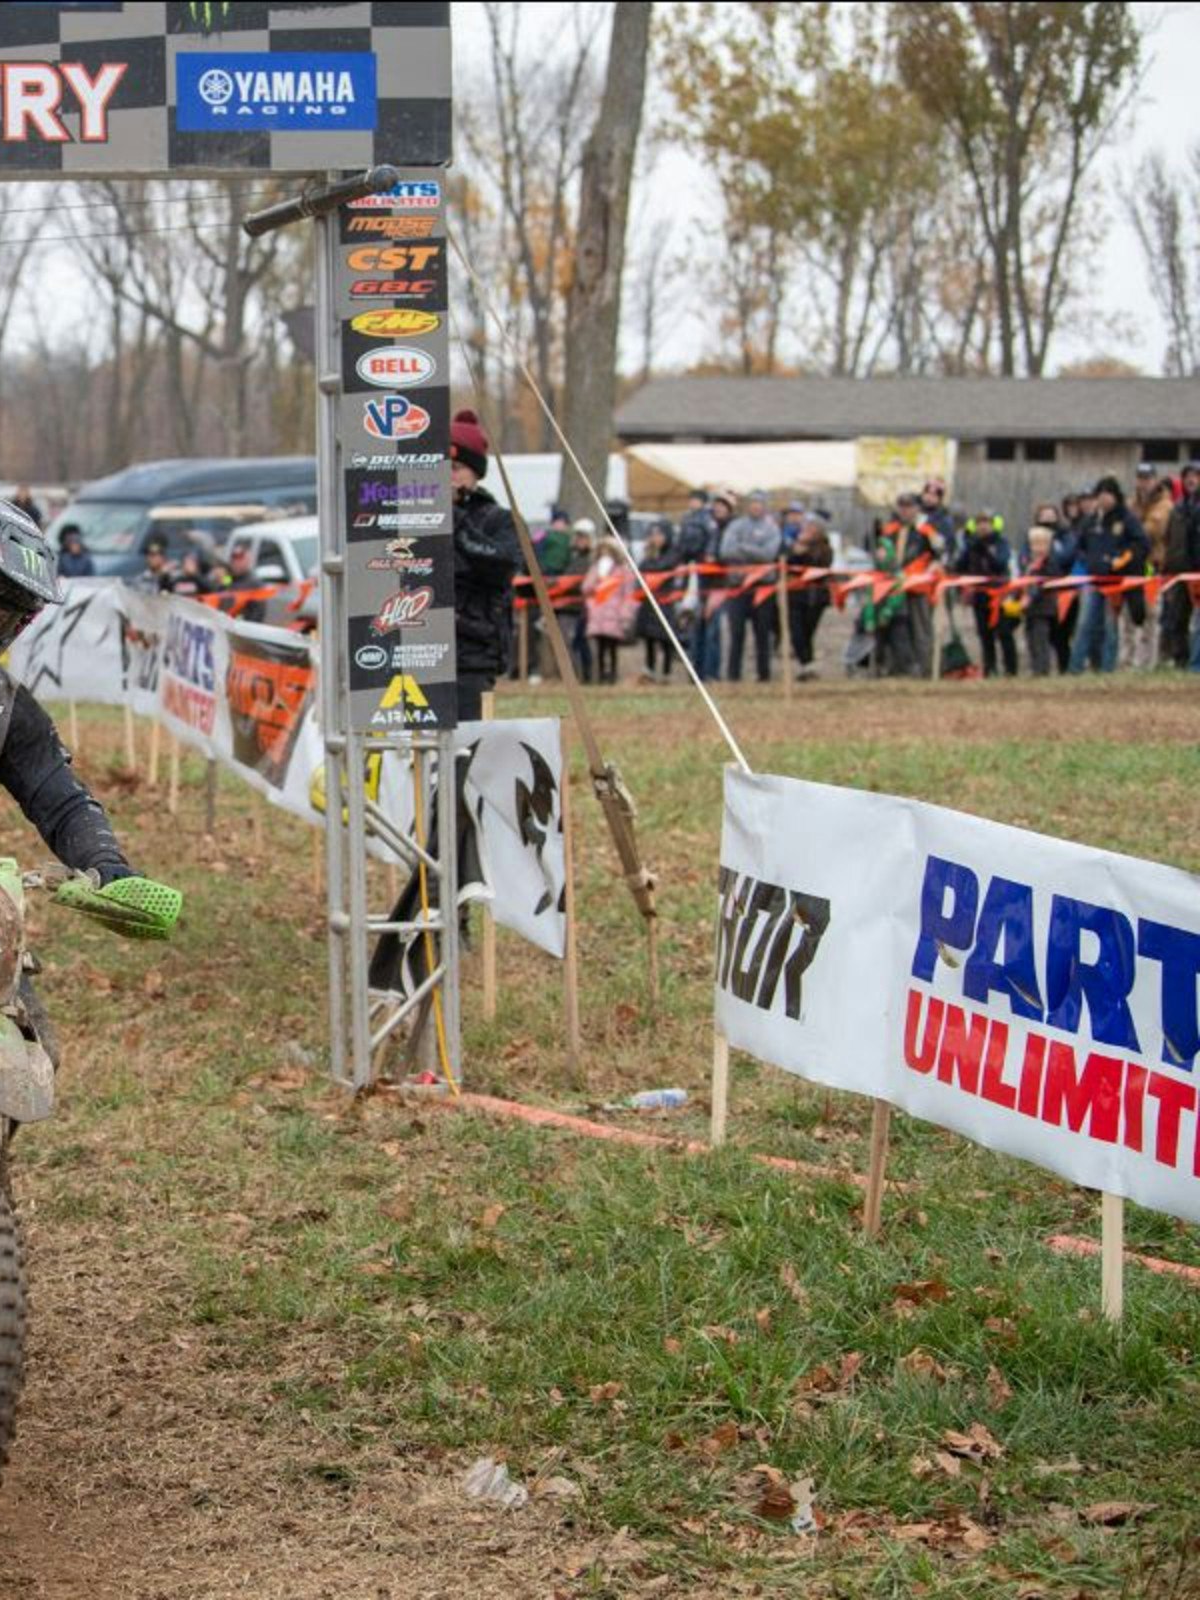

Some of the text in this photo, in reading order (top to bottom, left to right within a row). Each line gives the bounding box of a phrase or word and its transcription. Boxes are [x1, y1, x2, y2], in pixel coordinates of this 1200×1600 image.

[235, 71, 355, 103] YAMAHA
[211, 105, 347, 115] RACING
[347, 246, 439, 271] CST
[350, 280, 435, 294] GBC
[369, 358, 422, 373] BELL
[365, 396, 410, 438] VP
[369, 454, 444, 465] DUNLOP
[371, 710, 439, 722] ARMA
[718, 865, 831, 1021] HOR
[911, 855, 1200, 1072] PART
[903, 988, 1200, 1179] UNLIMIT
